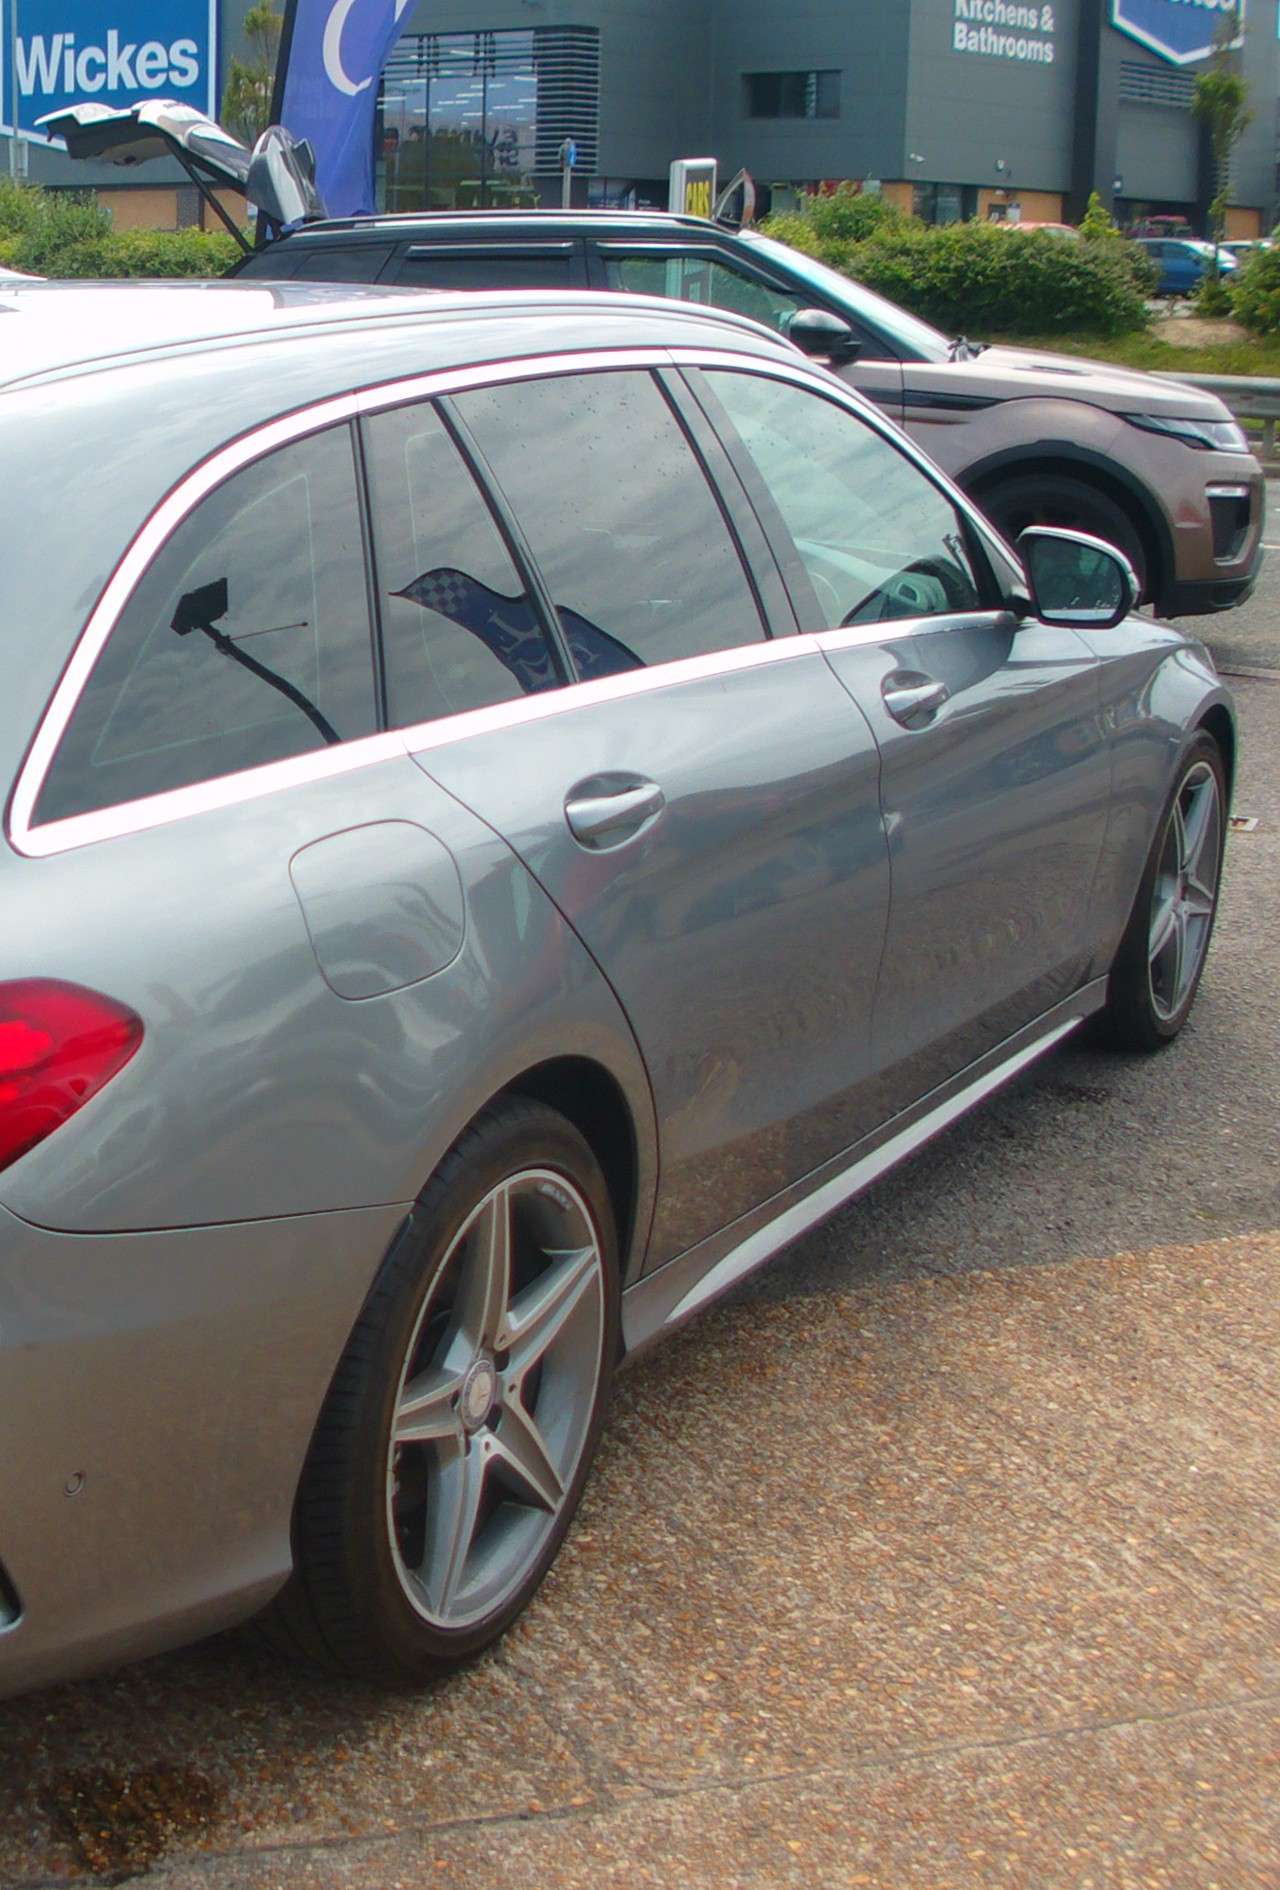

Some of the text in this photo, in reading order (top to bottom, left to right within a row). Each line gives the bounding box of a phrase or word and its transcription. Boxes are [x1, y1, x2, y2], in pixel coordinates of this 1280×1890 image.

[1040, 5, 1054, 32] &
[16, 29, 199, 95] Wickes
[953, 21, 1055, 63] Bathrooms
